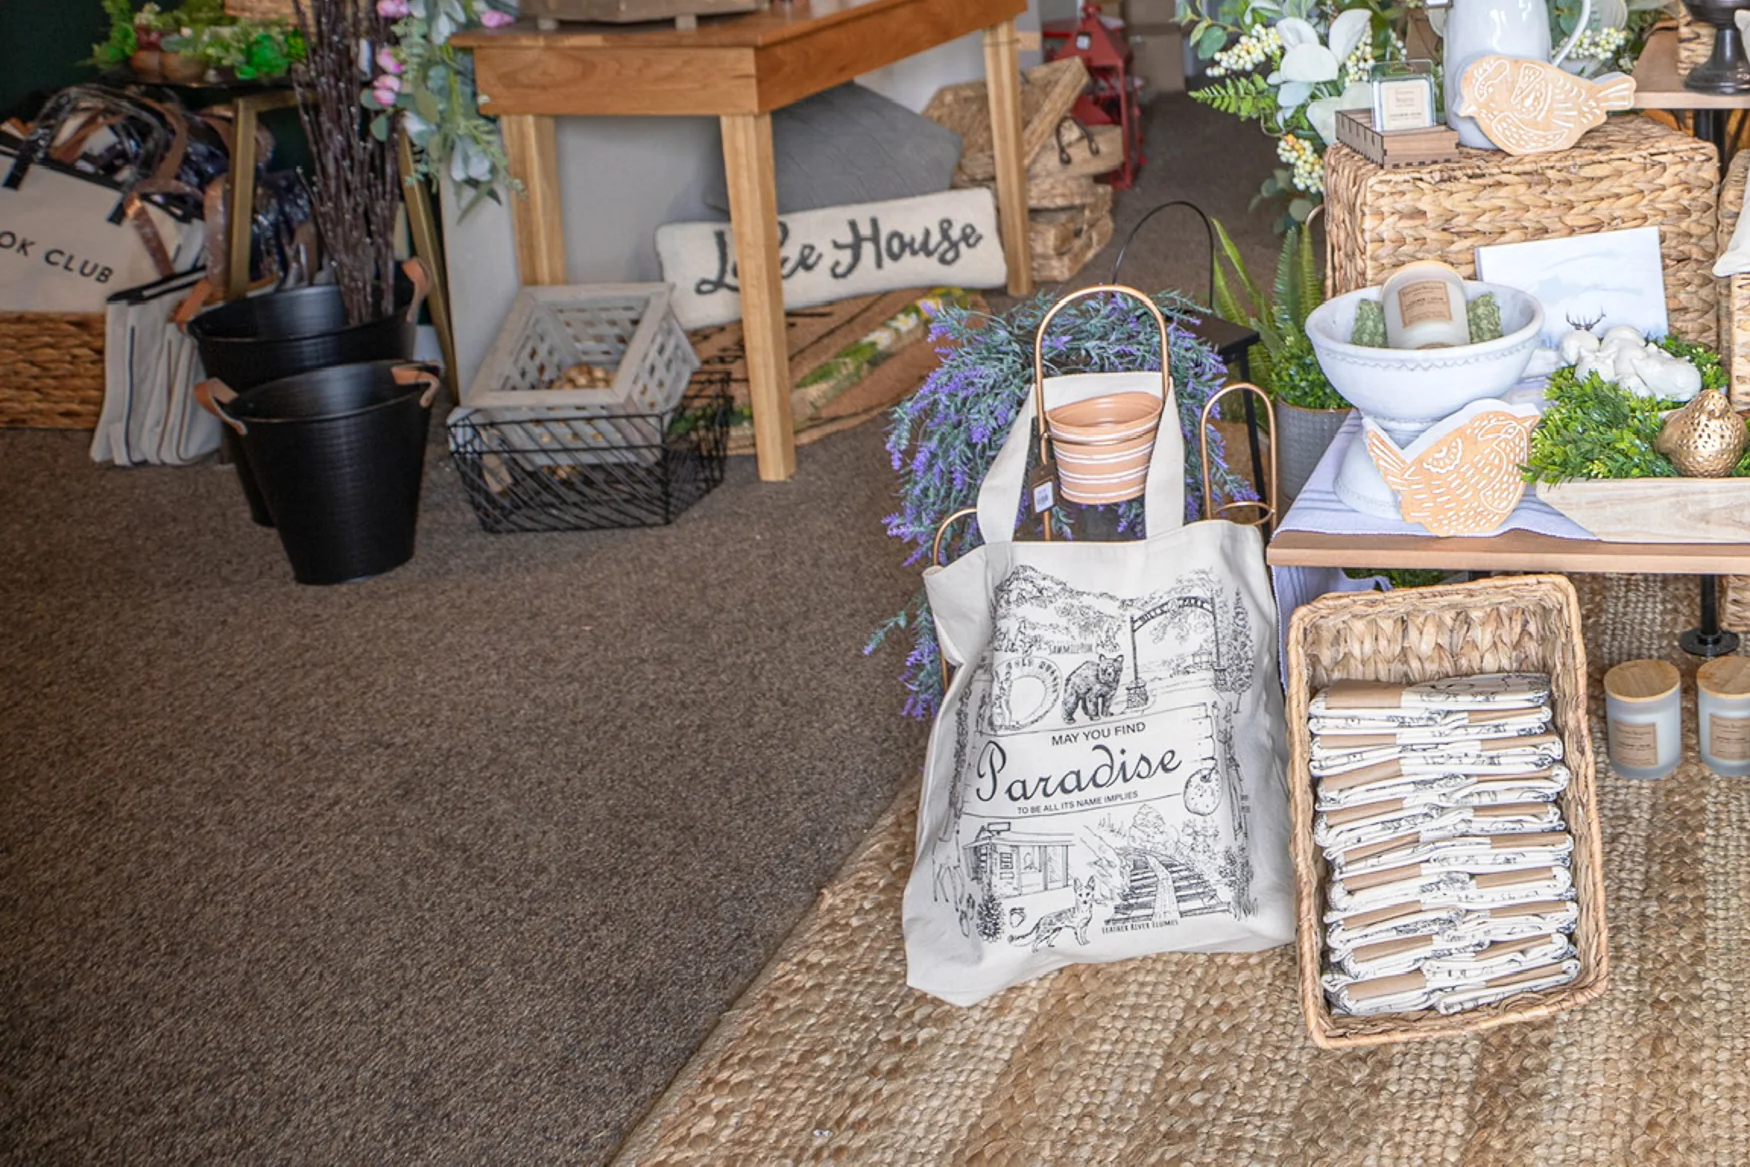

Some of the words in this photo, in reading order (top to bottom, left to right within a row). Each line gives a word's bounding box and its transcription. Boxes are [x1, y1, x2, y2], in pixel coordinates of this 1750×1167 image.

[830, 216, 984, 279] House
[44, 249, 114, 284] CLUB
[1051, 732, 1081, 747] MAY
[1082, 727, 1112, 743] YOU
[1114, 721, 1146, 737] FIND
[976, 739, 1182, 802] Paradise
[1017, 806, 1029, 815] TO
[1030, 805, 1041, 814] BE
[1043, 803, 1060, 813] ALL
[1061, 800, 1074, 810] ITS
[1076, 796, 1103, 808] NAME
[1104, 790, 1139, 803] IMPLIES
